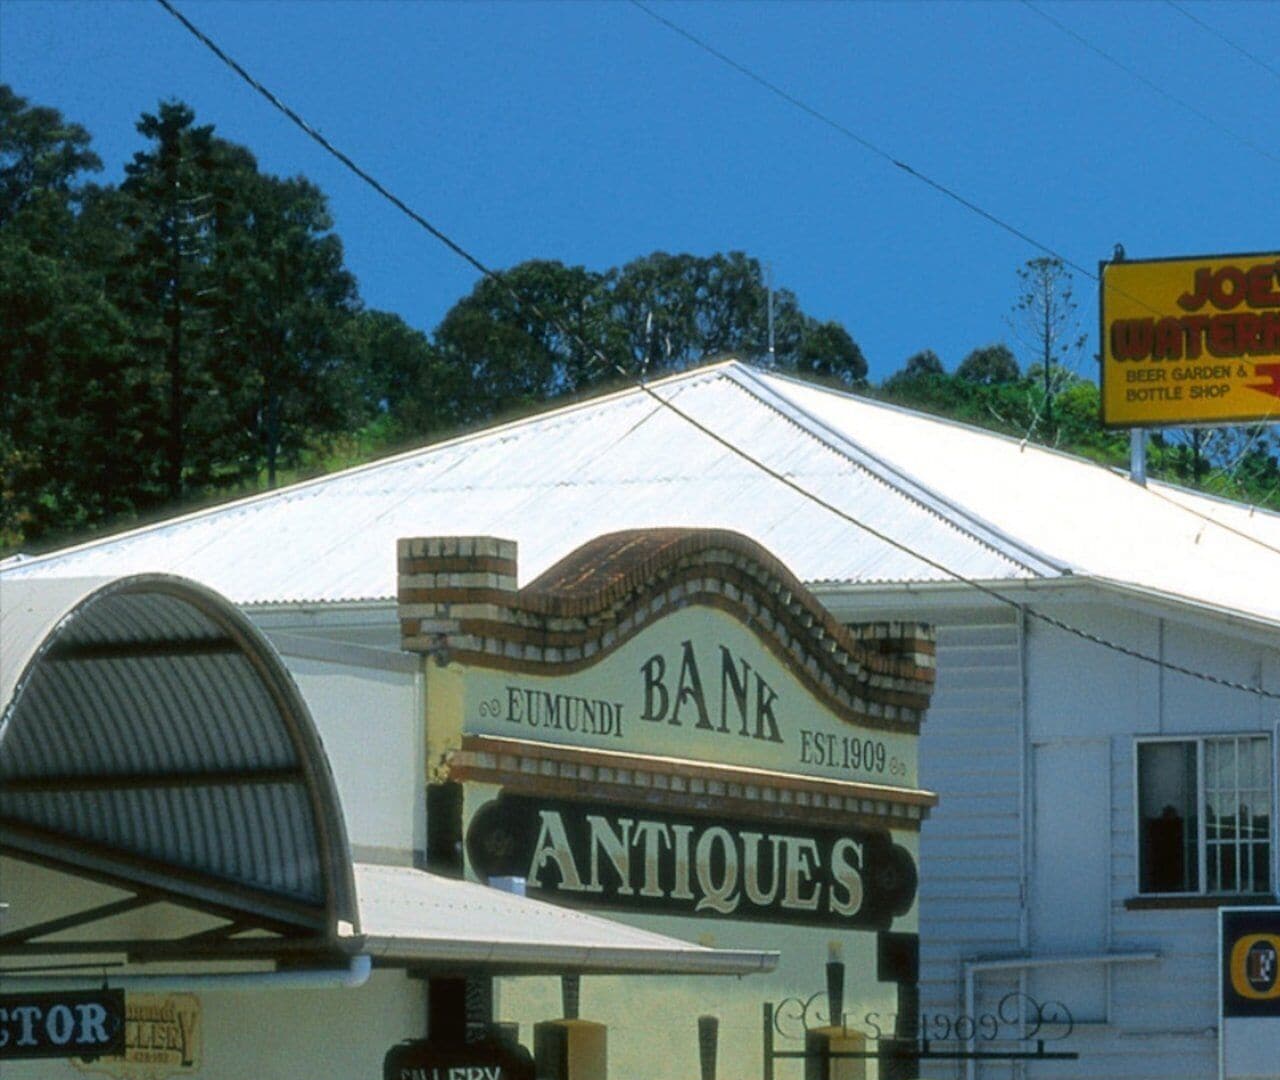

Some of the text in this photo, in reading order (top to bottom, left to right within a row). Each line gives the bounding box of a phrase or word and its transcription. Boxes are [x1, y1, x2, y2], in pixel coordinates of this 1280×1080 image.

[1126, 366, 1247, 383] BEER GARDEN &
[1126, 384, 1231, 402] BOTTLE SHOP
[505, 687, 625, 738] EUMUNDI
[640, 640, 784, 743] BANK
[527, 811, 864, 919] ANTIQUES
